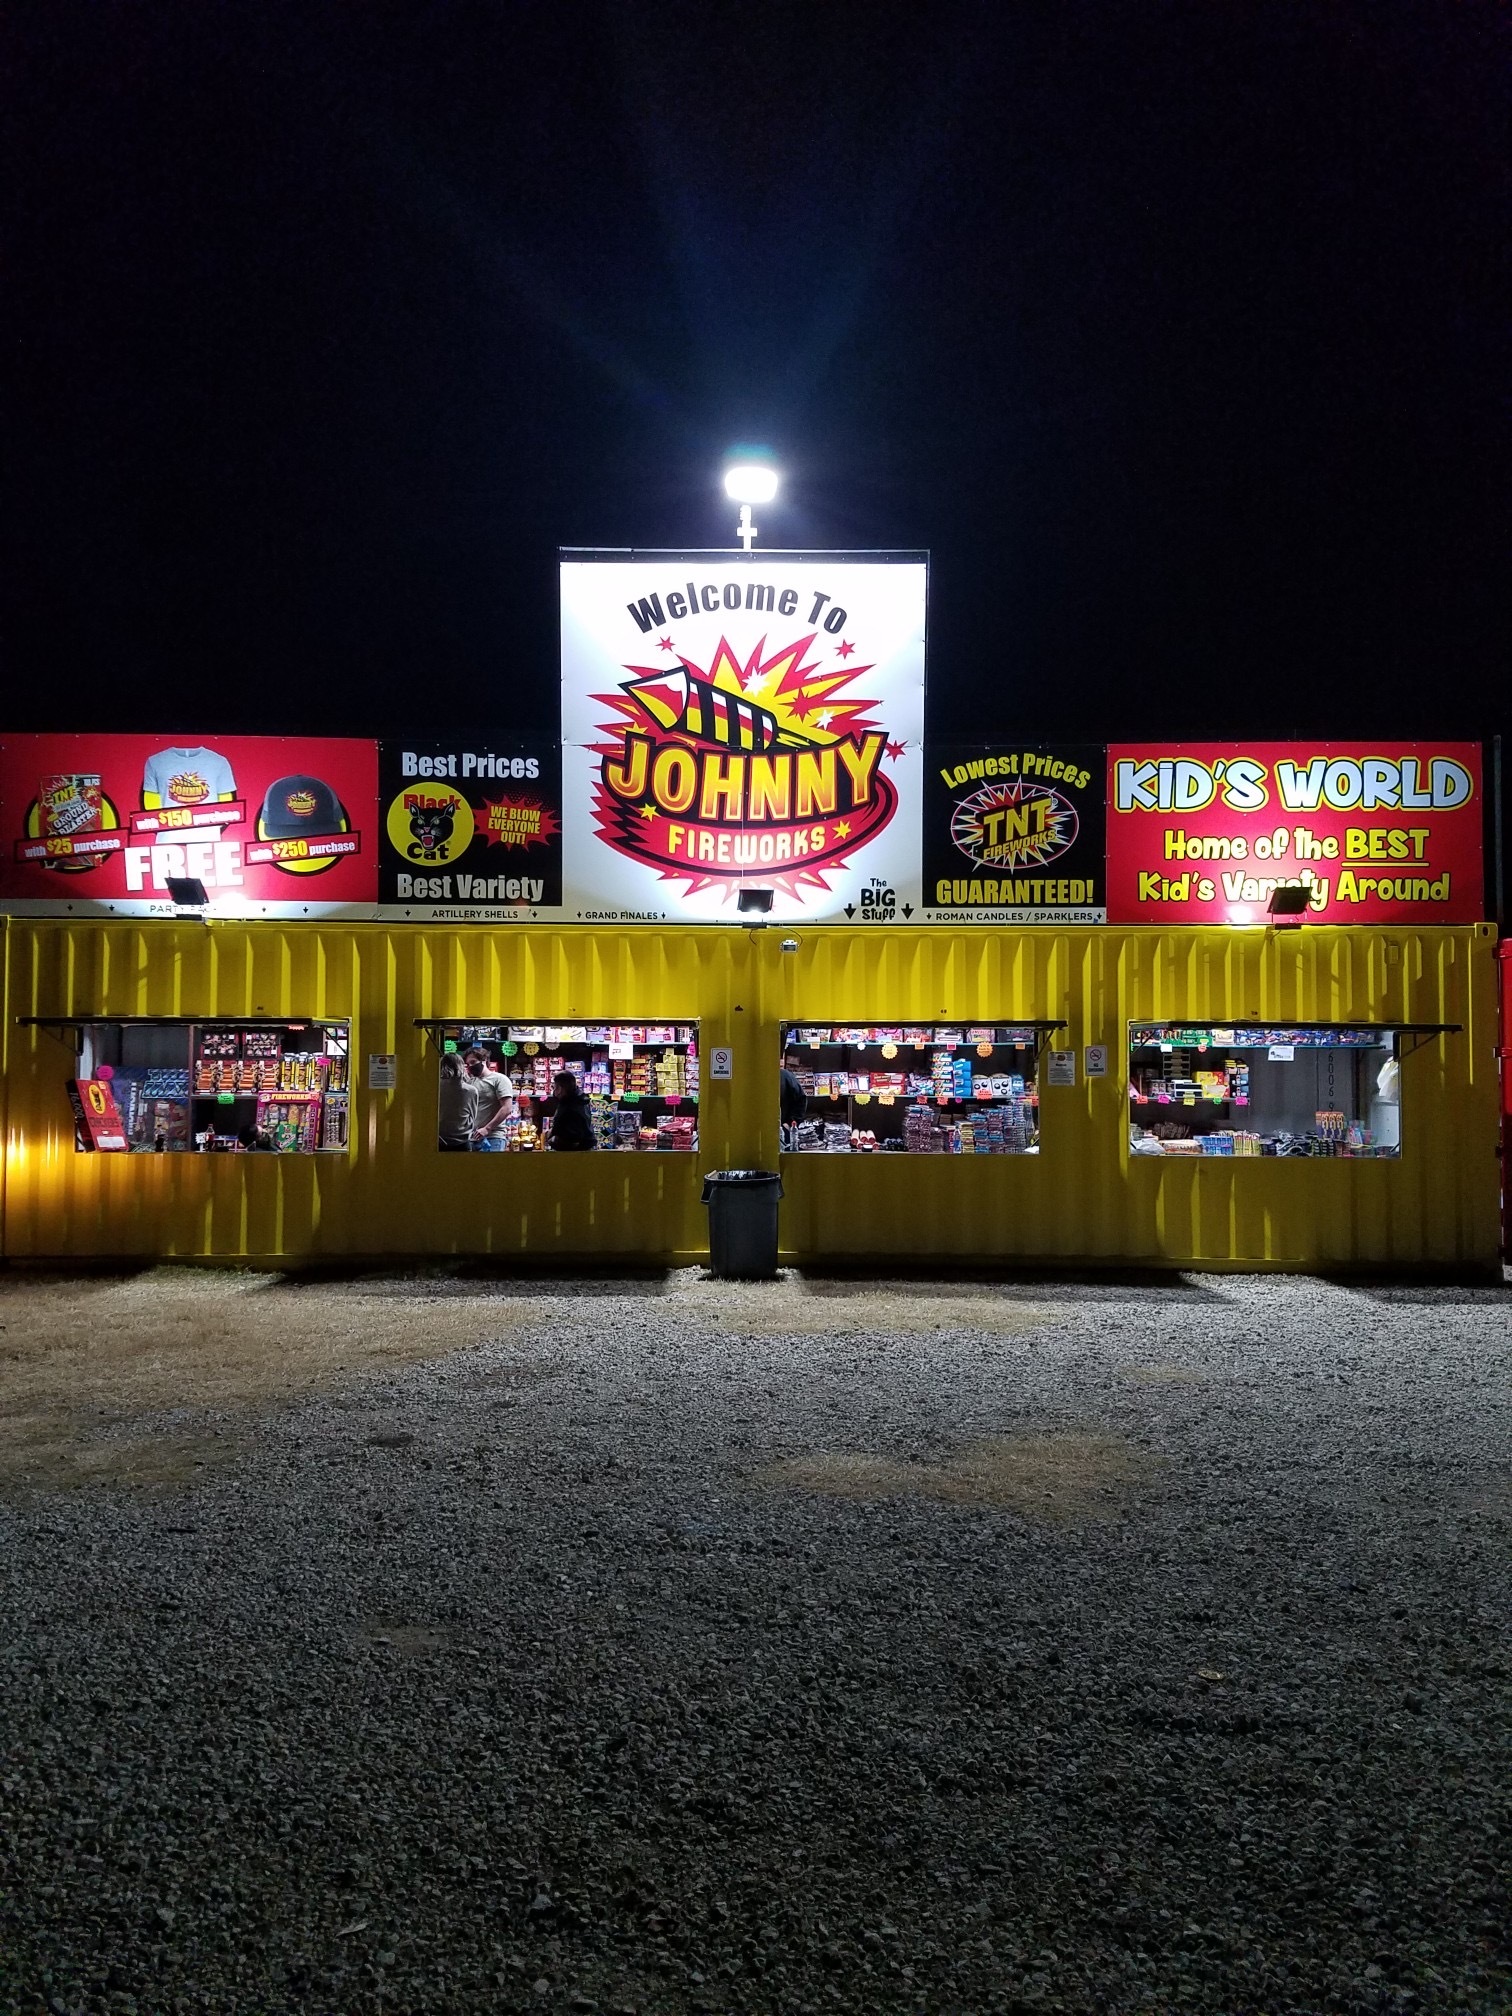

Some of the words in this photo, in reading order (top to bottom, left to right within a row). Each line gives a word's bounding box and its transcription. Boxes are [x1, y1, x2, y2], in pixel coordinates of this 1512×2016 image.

[627, 582, 799, 634] Welcome
[807, 591, 847, 634] To
[402, 752, 457, 777] Best
[462, 753, 540, 778] Prices
[939, 754, 1018, 789] Lowest
[1022, 753, 1091, 789] Prices
[603, 732, 887, 822] JOHNNY
[1274, 756, 1474, 812] WORLD
[53, 785, 76, 804] TNT
[170, 784, 208, 797] JOHNNY
[403, 794, 462, 810] Black
[53, 802, 88, 829] GROUND
[158, 810, 193, 827] $150
[490, 806, 508, 819] WE
[509, 807, 541, 822] BLOW
[983, 797, 1053, 846] TNT
[488, 817, 541, 834] EVERYONE
[24, 845, 46, 858] with
[46, 838, 72, 854] $25
[73, 839, 121, 854] purchase
[272, 841, 308, 858] $250
[309, 841, 356, 856] purchase
[501, 832, 526, 845] OUT!
[668, 825, 827, 864] FIREWORKS
[983, 829, 1057, 860] FIREWORKS
[1163, 829, 1249, 860] Home
[1254, 827, 1289, 860] of
[1345, 828, 1431, 860] BEST
[406, 842, 449, 860] Cat
[124, 841, 244, 891] FREE
[397, 874, 453, 898] Best
[456, 874, 545, 902] Variety
[870, 878, 887, 887] The
[936, 879, 1094, 904] GUARANTEED!
[1138, 872, 1216, 902] Kid's
[1336, 870, 1450, 902] Around
[431, 910, 482, 919] ARTILLERY
[484, 910, 519, 919] SHELLS
[585, 911, 618, 920] GRAND
[620, 911, 659, 920] FINALES
[936, 913, 973, 921] ROMAN
[976, 913, 1024, 921] CANDLES
[1034, 913, 1093, 921] SPARKLERS
